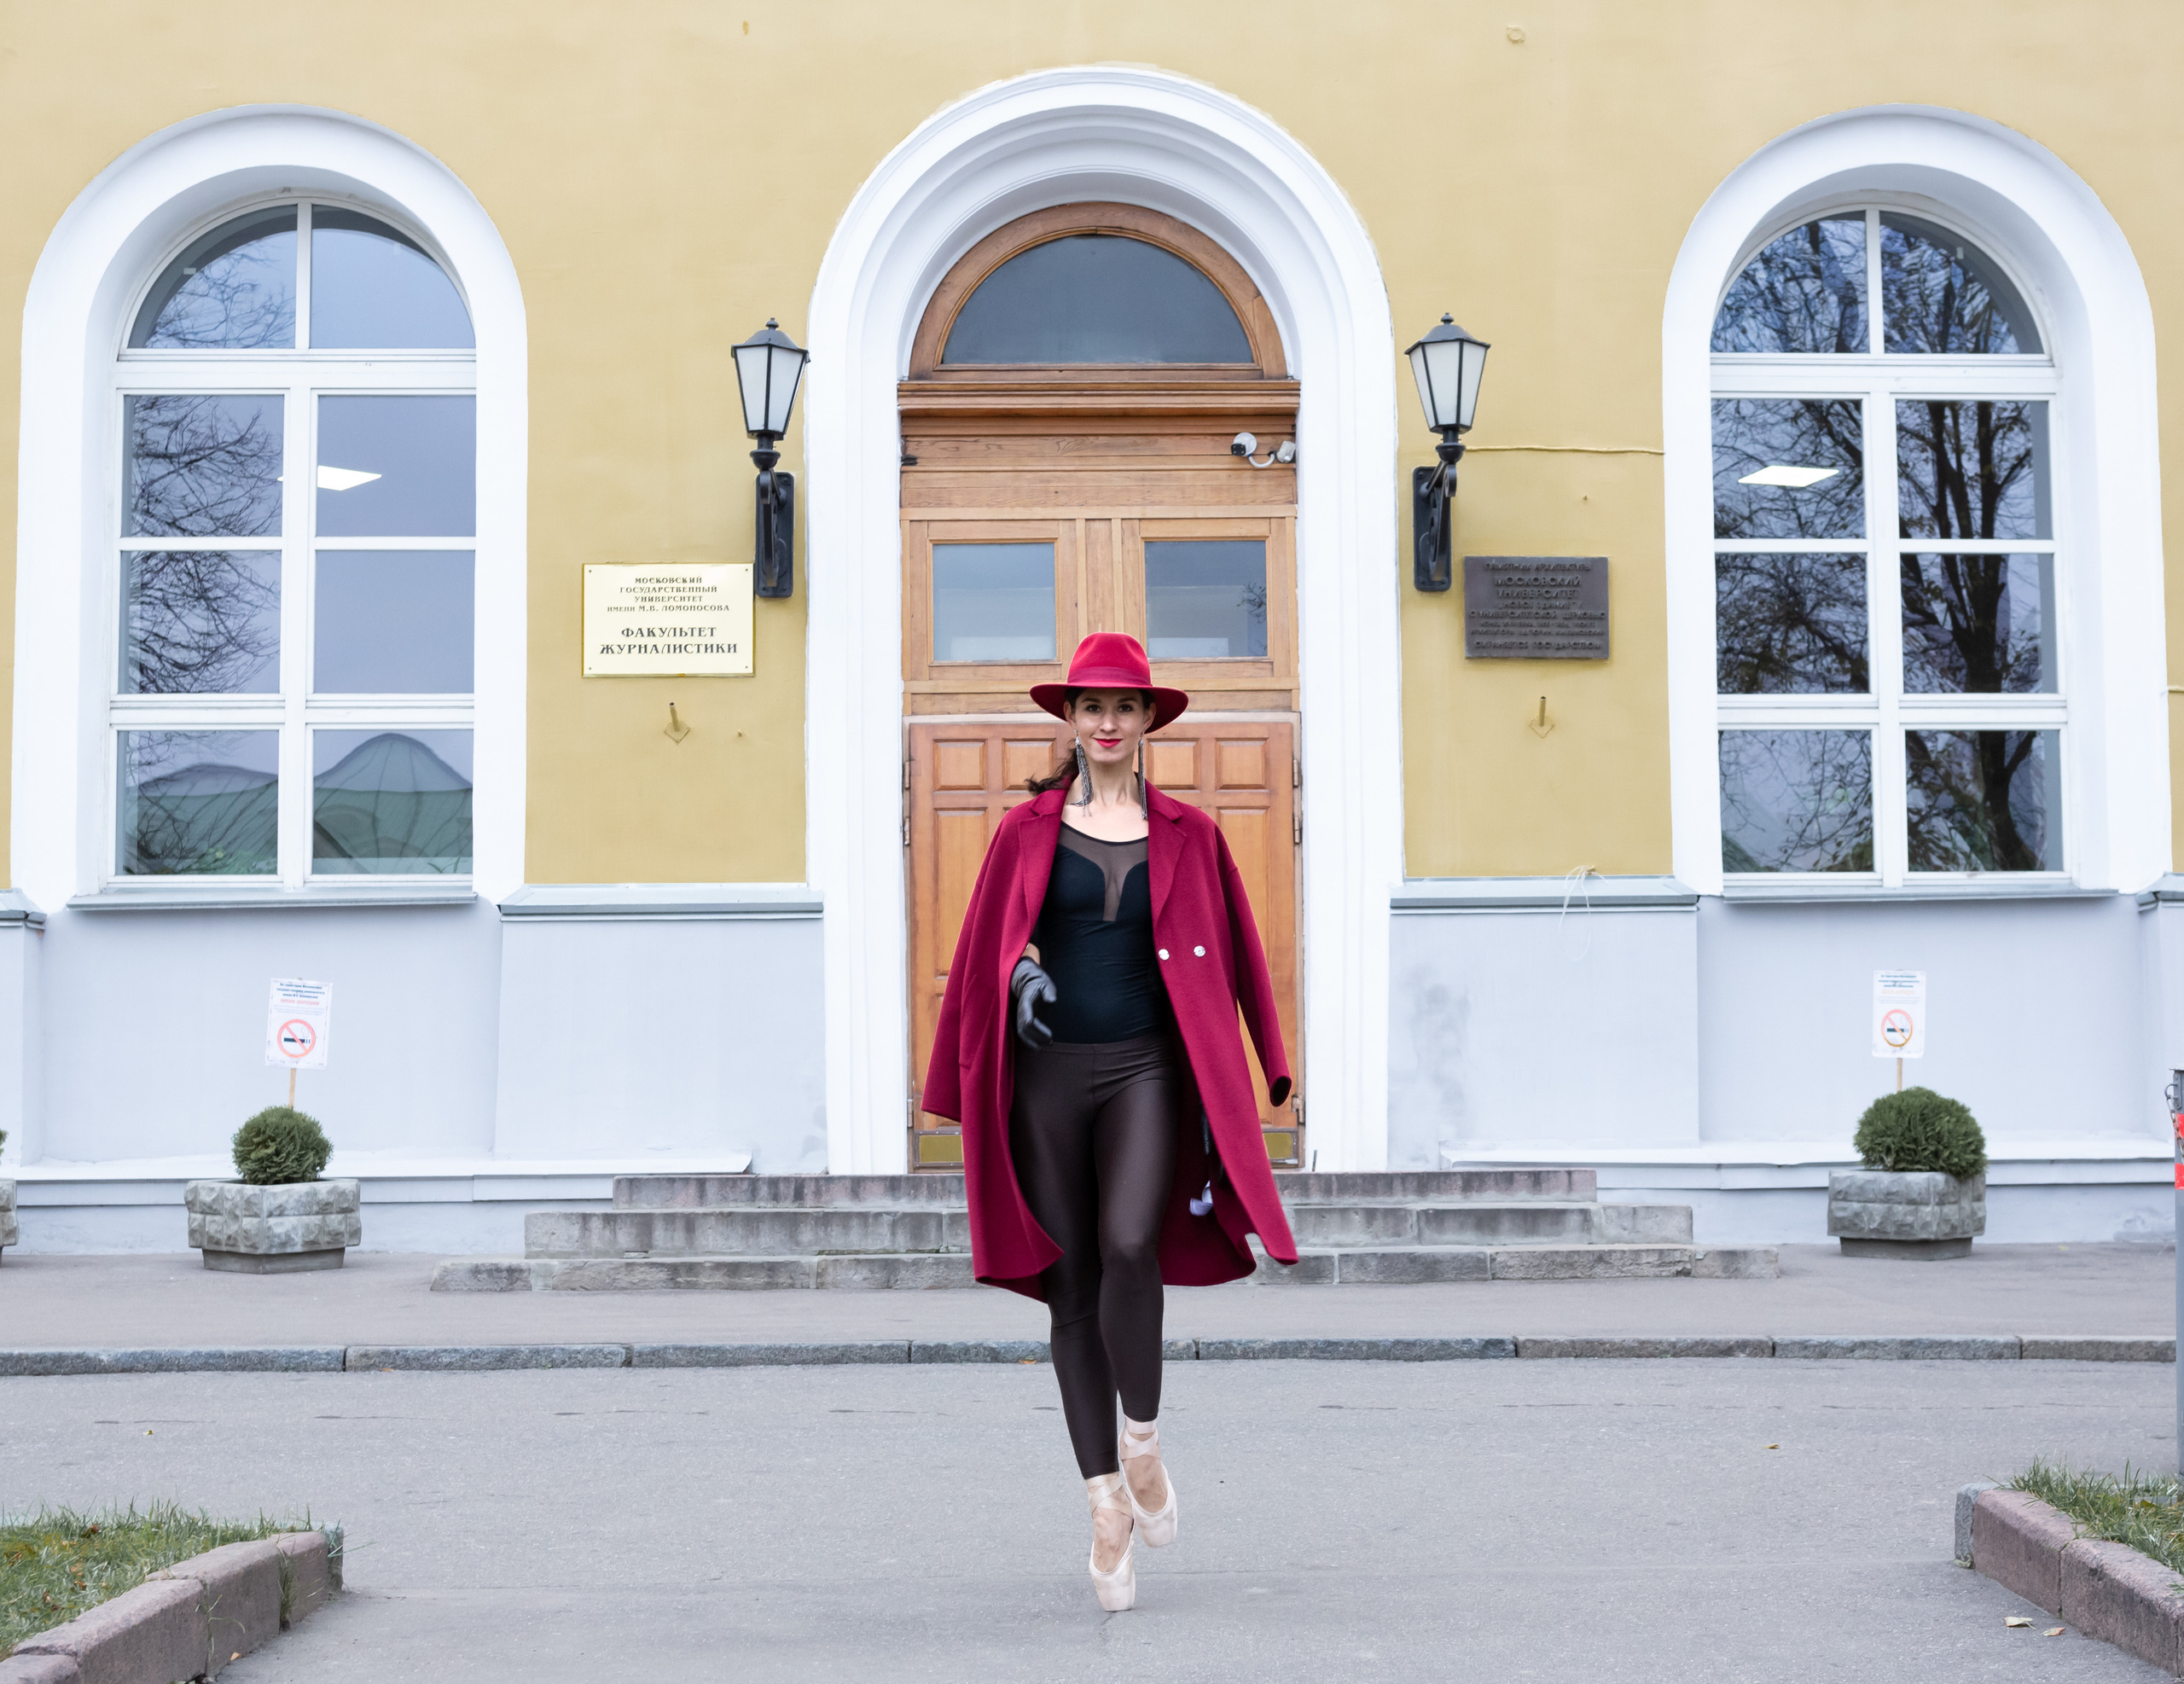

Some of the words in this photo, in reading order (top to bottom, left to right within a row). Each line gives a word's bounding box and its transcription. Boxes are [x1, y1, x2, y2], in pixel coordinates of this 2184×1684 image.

[635, 576, 702, 584] МОСКОВСКИЙ
[1495, 575, 1582, 587] МОСКОВСКИЙ
[620, 585, 717, 594] ГОСУДАРСТВЕННЫЙ
[1496, 588, 1580, 599] УНИВЕРСИТЕТ
[621, 626, 717, 638] ФАКУЛЬТЕТ
[600, 642, 738, 654] ЖУРНАЛИСТИКИ
